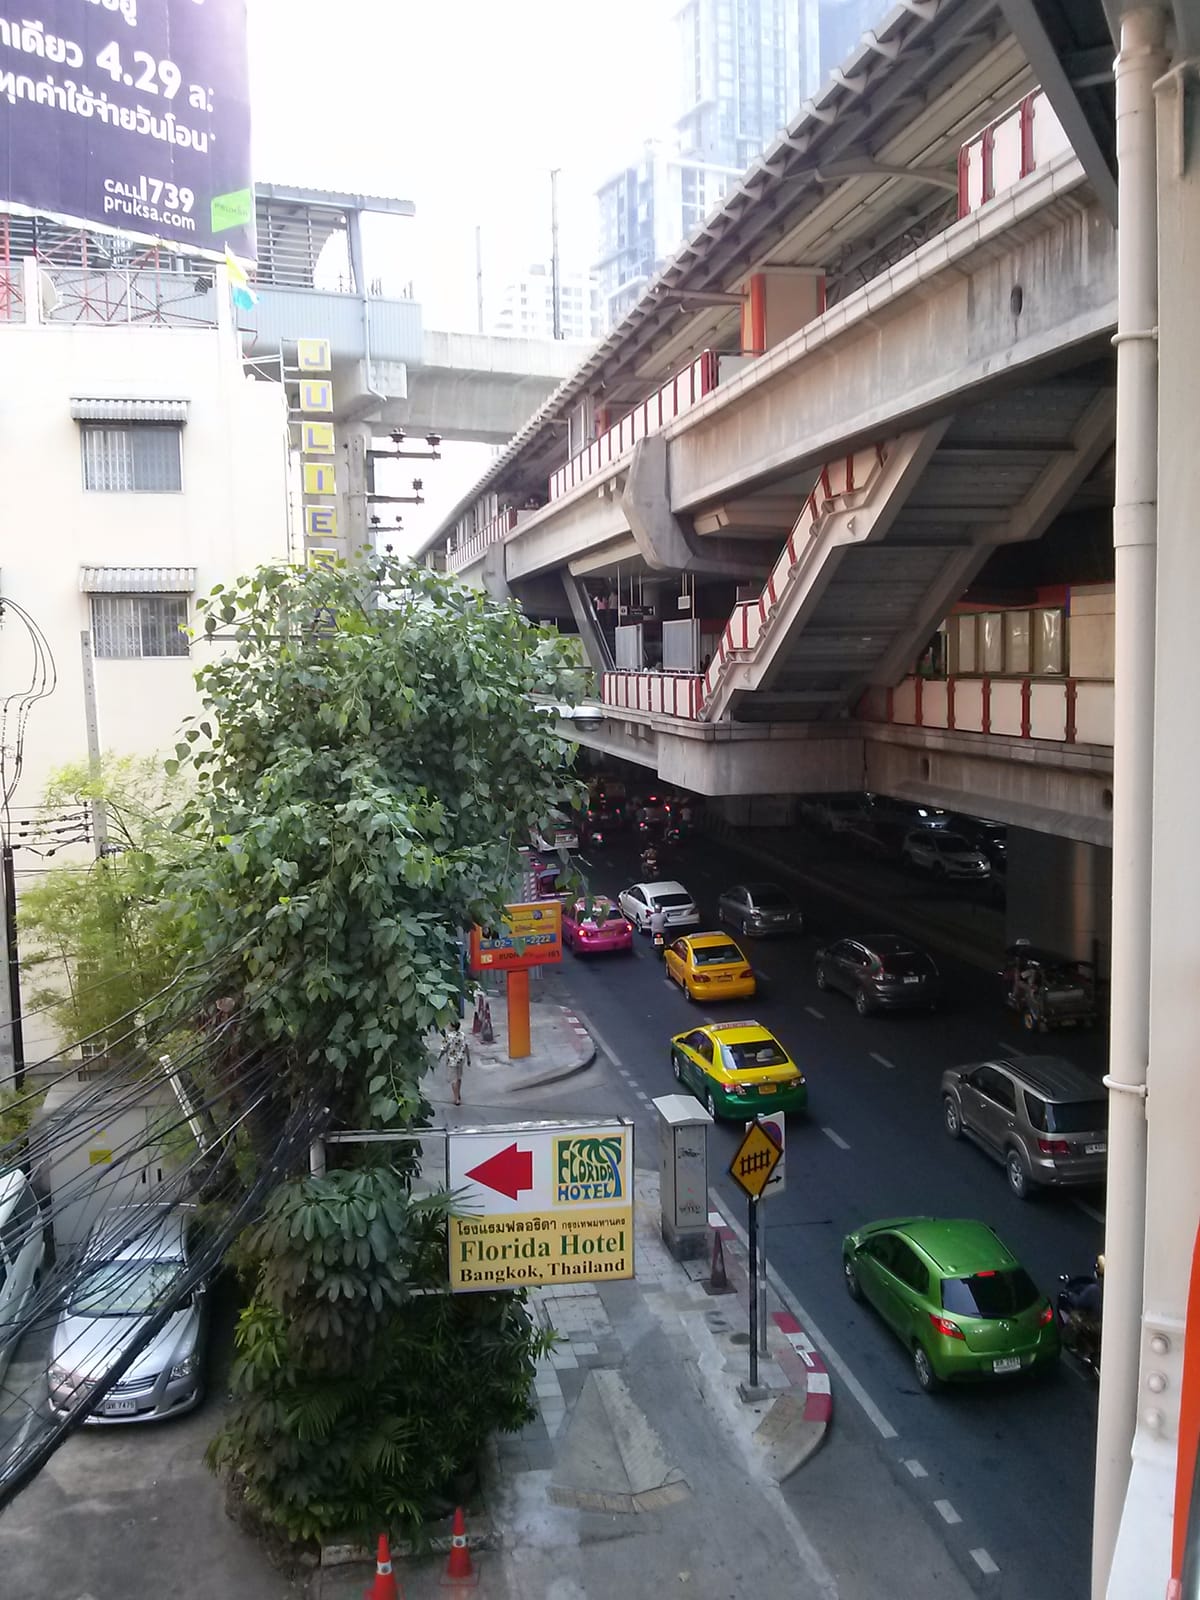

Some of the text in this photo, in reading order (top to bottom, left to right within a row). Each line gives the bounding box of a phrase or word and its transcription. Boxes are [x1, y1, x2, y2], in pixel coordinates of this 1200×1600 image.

[96, 40, 182, 100] 4.29
[104, 179, 141, 200] CALL
[140, 175, 195, 213] 1739
[103, 195, 196, 231] pruksa.com
[558, 1140, 615, 1184] FLORIDA
[558, 1183, 613, 1201] HOTEL
[461, 1231, 624, 1262] Florida Hotel
[461, 1258, 625, 1283] Bangkok, Thailand
